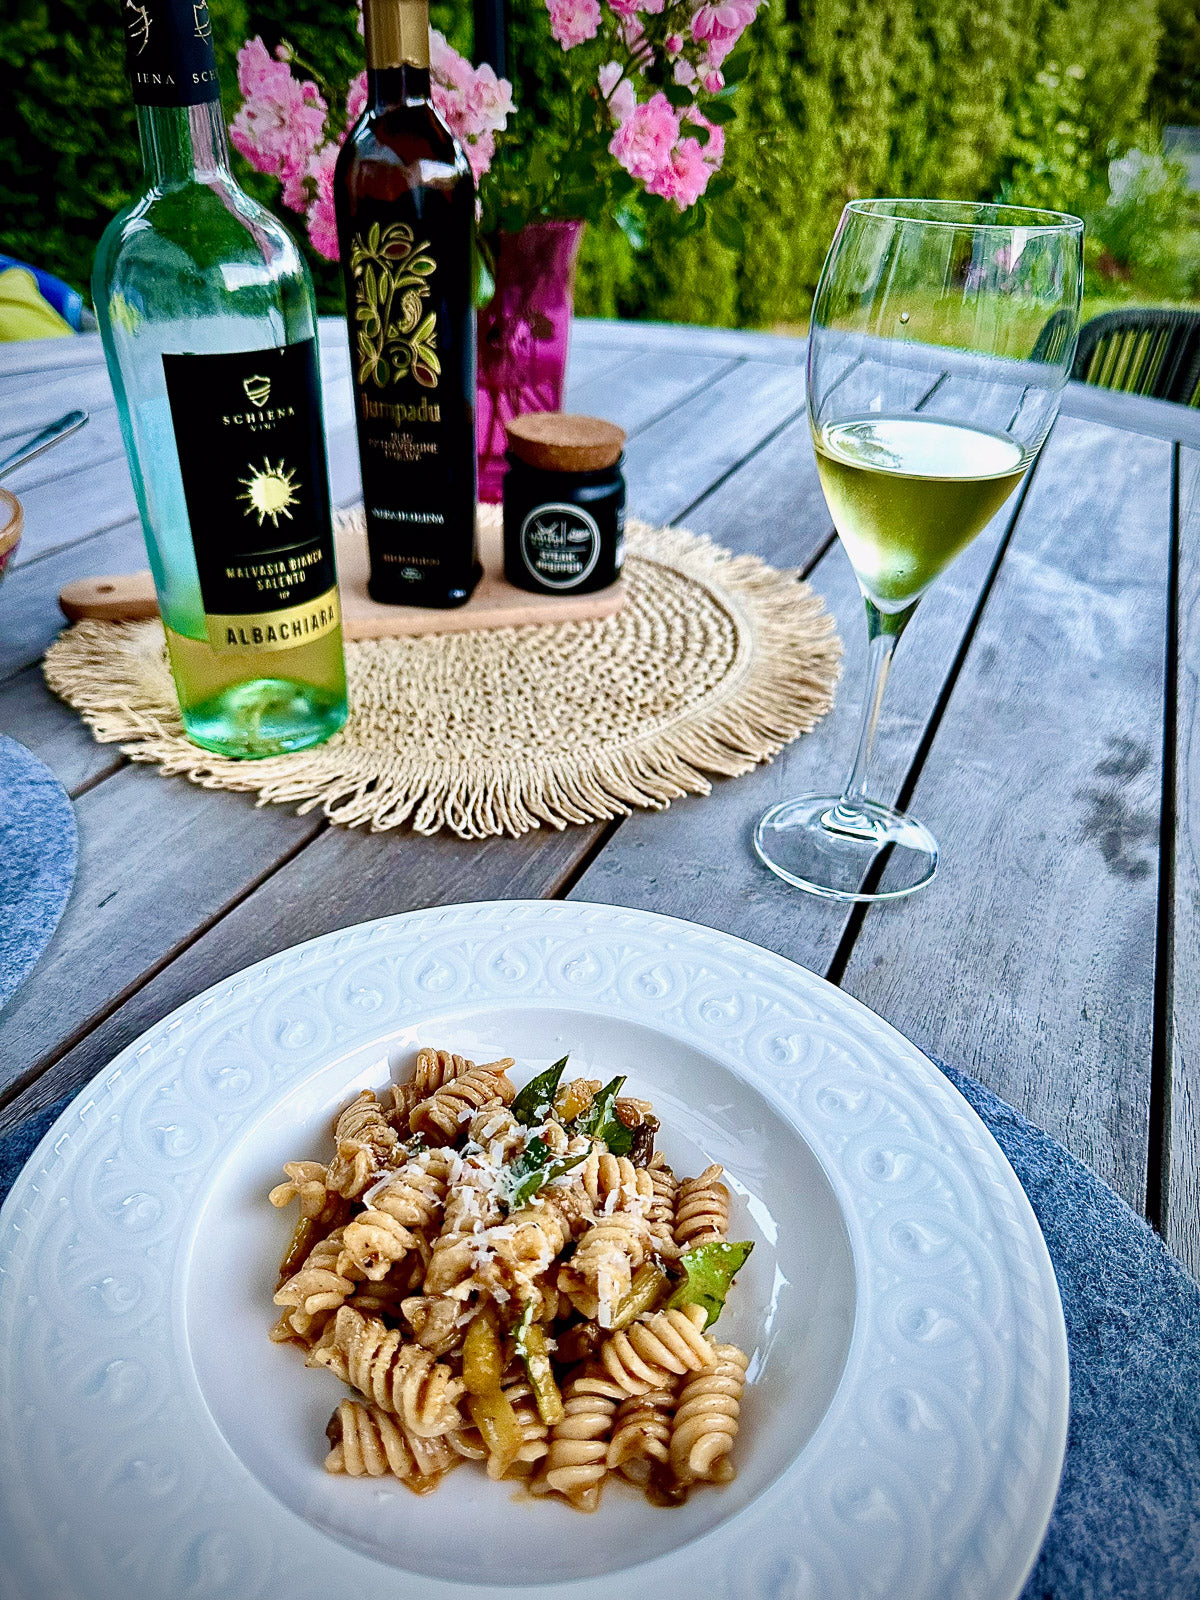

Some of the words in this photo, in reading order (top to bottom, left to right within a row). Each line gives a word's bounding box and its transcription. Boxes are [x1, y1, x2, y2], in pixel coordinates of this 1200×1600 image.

[222, 406, 295, 425] SCHIENA
[225, 561, 286, 578] MALVASIA
[256, 570, 306, 591] SALENTO
[227, 605, 335, 645] ALBACHIARA
